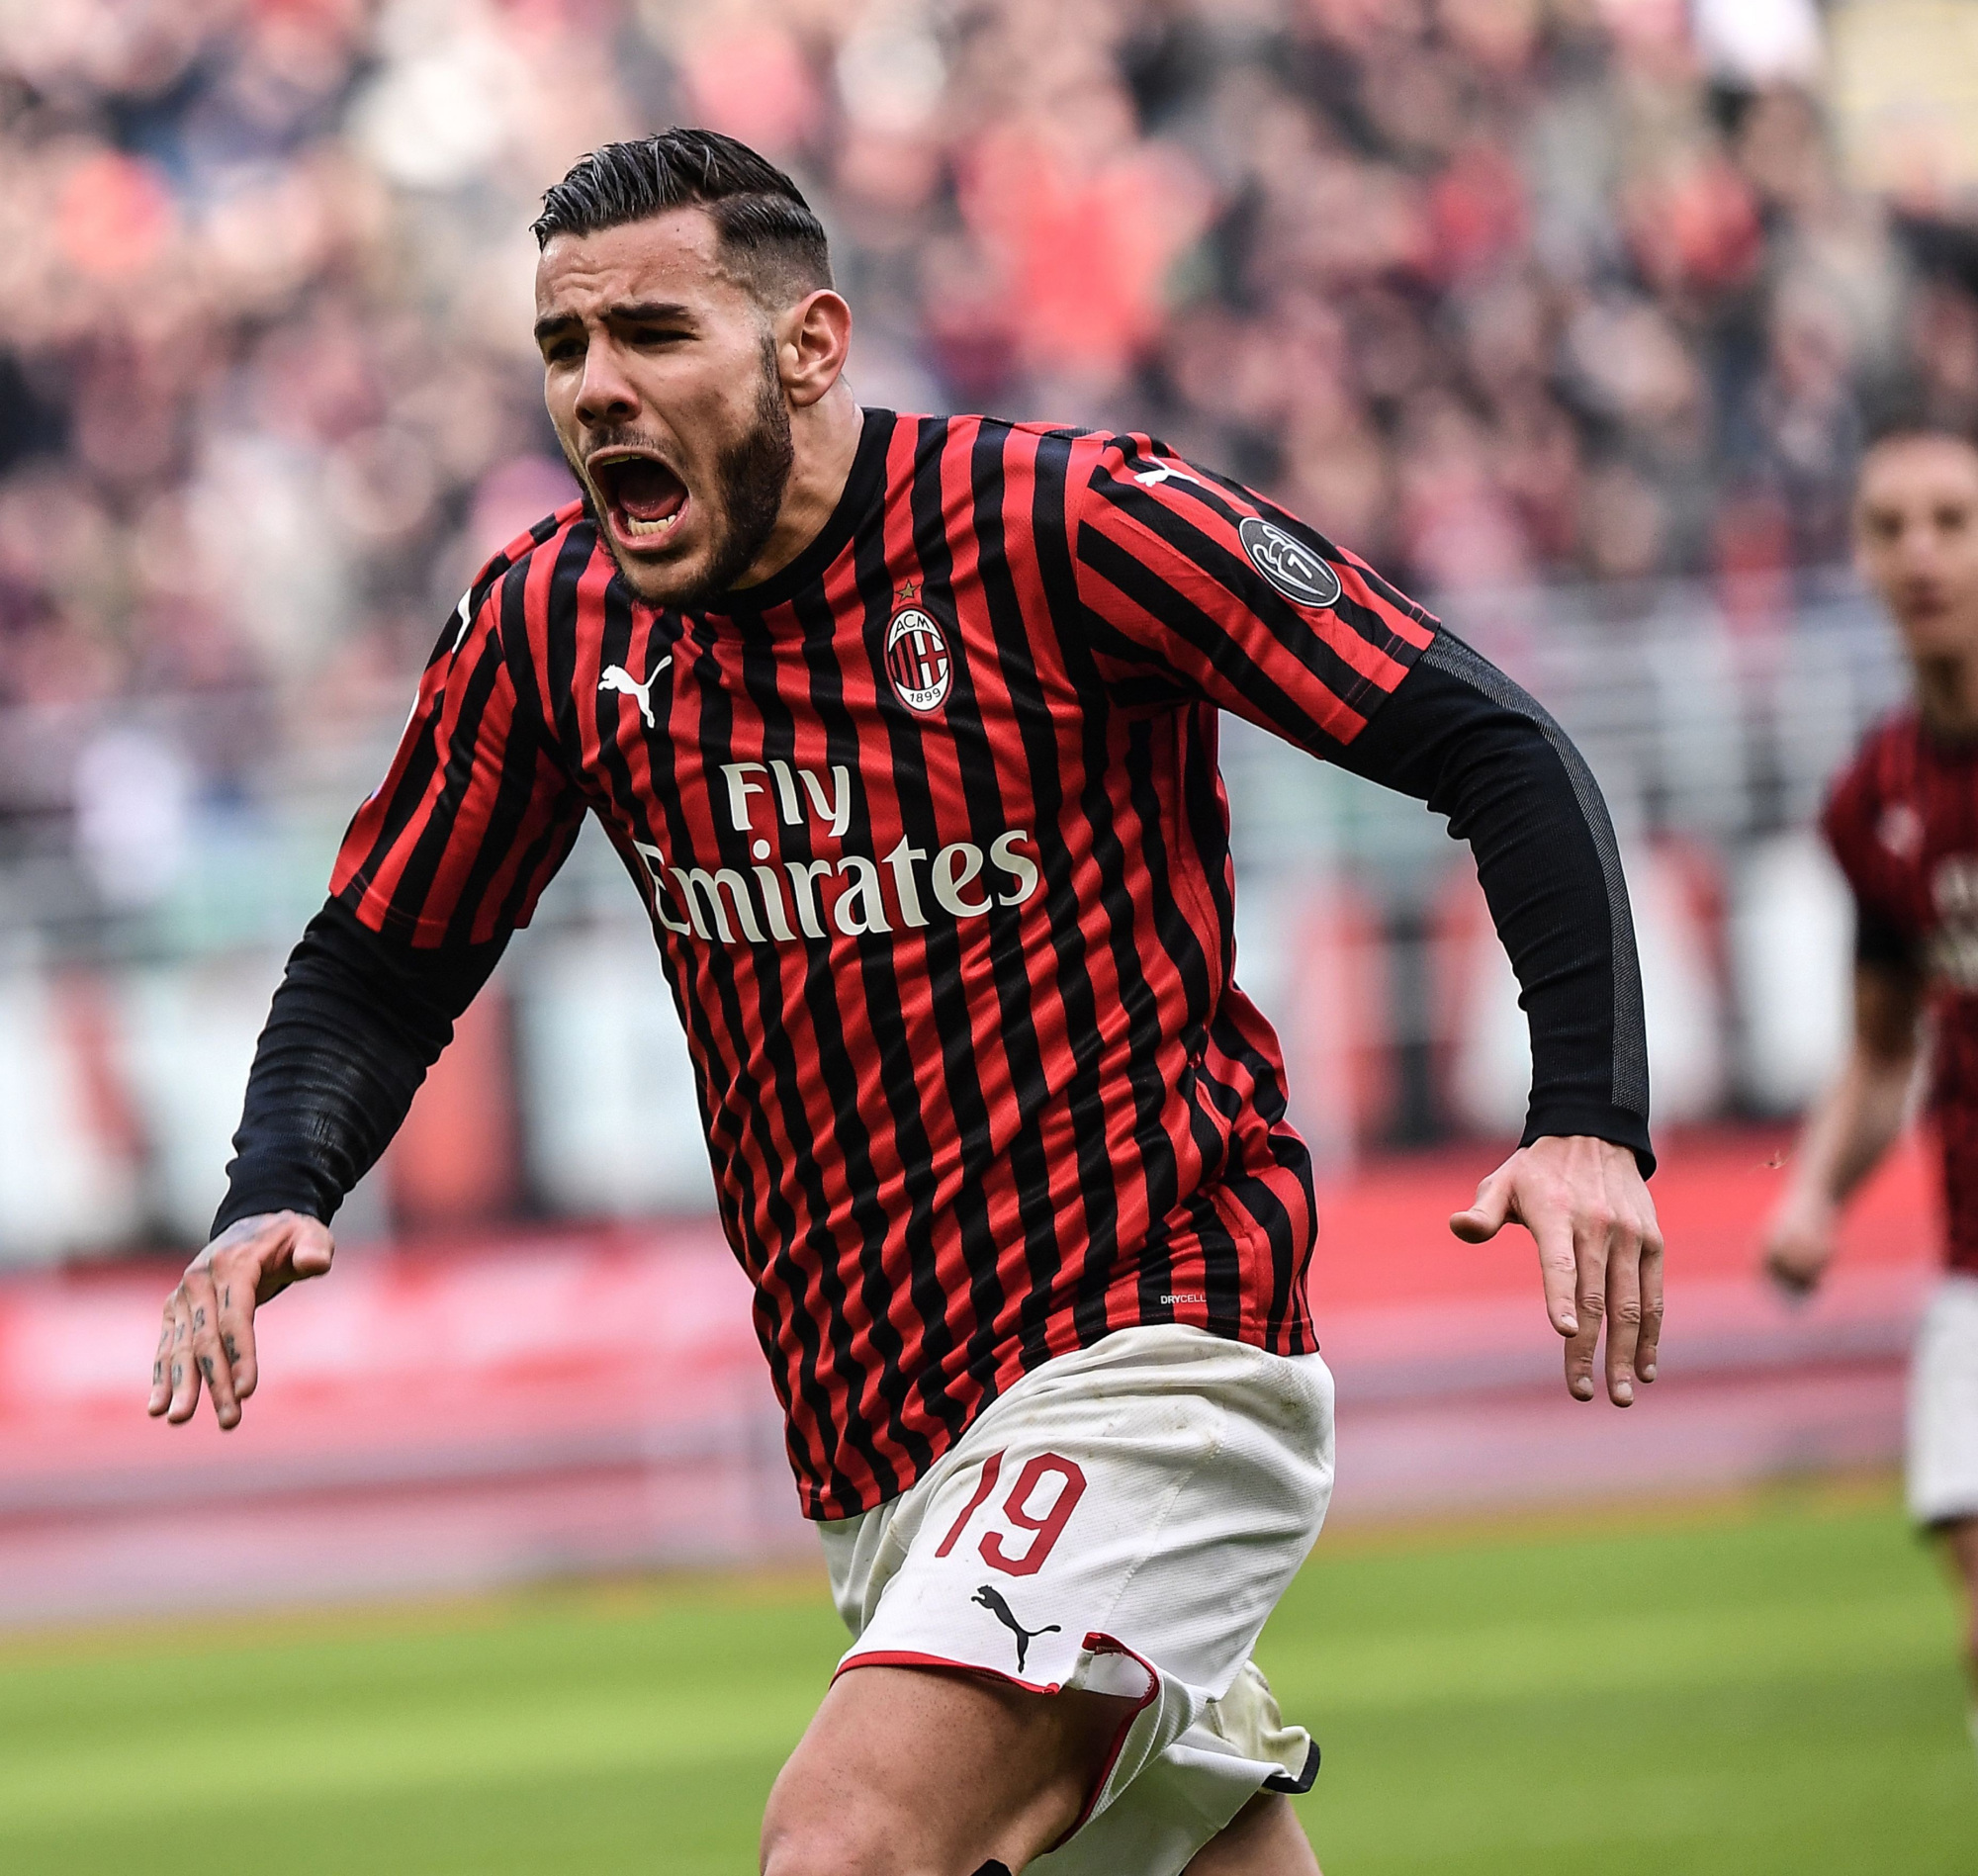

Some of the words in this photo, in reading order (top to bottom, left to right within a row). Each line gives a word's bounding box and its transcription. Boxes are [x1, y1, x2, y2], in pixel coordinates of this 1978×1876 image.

[893, 613, 931, 638] ACM
[909, 687, 942, 703] 1899
[719, 759, 851, 837] Fly
[633, 830, 1038, 943] Emirates
[1159, 1294, 1207, 1304] DRYCELL
[935, 1446, 1088, 1577] 19
